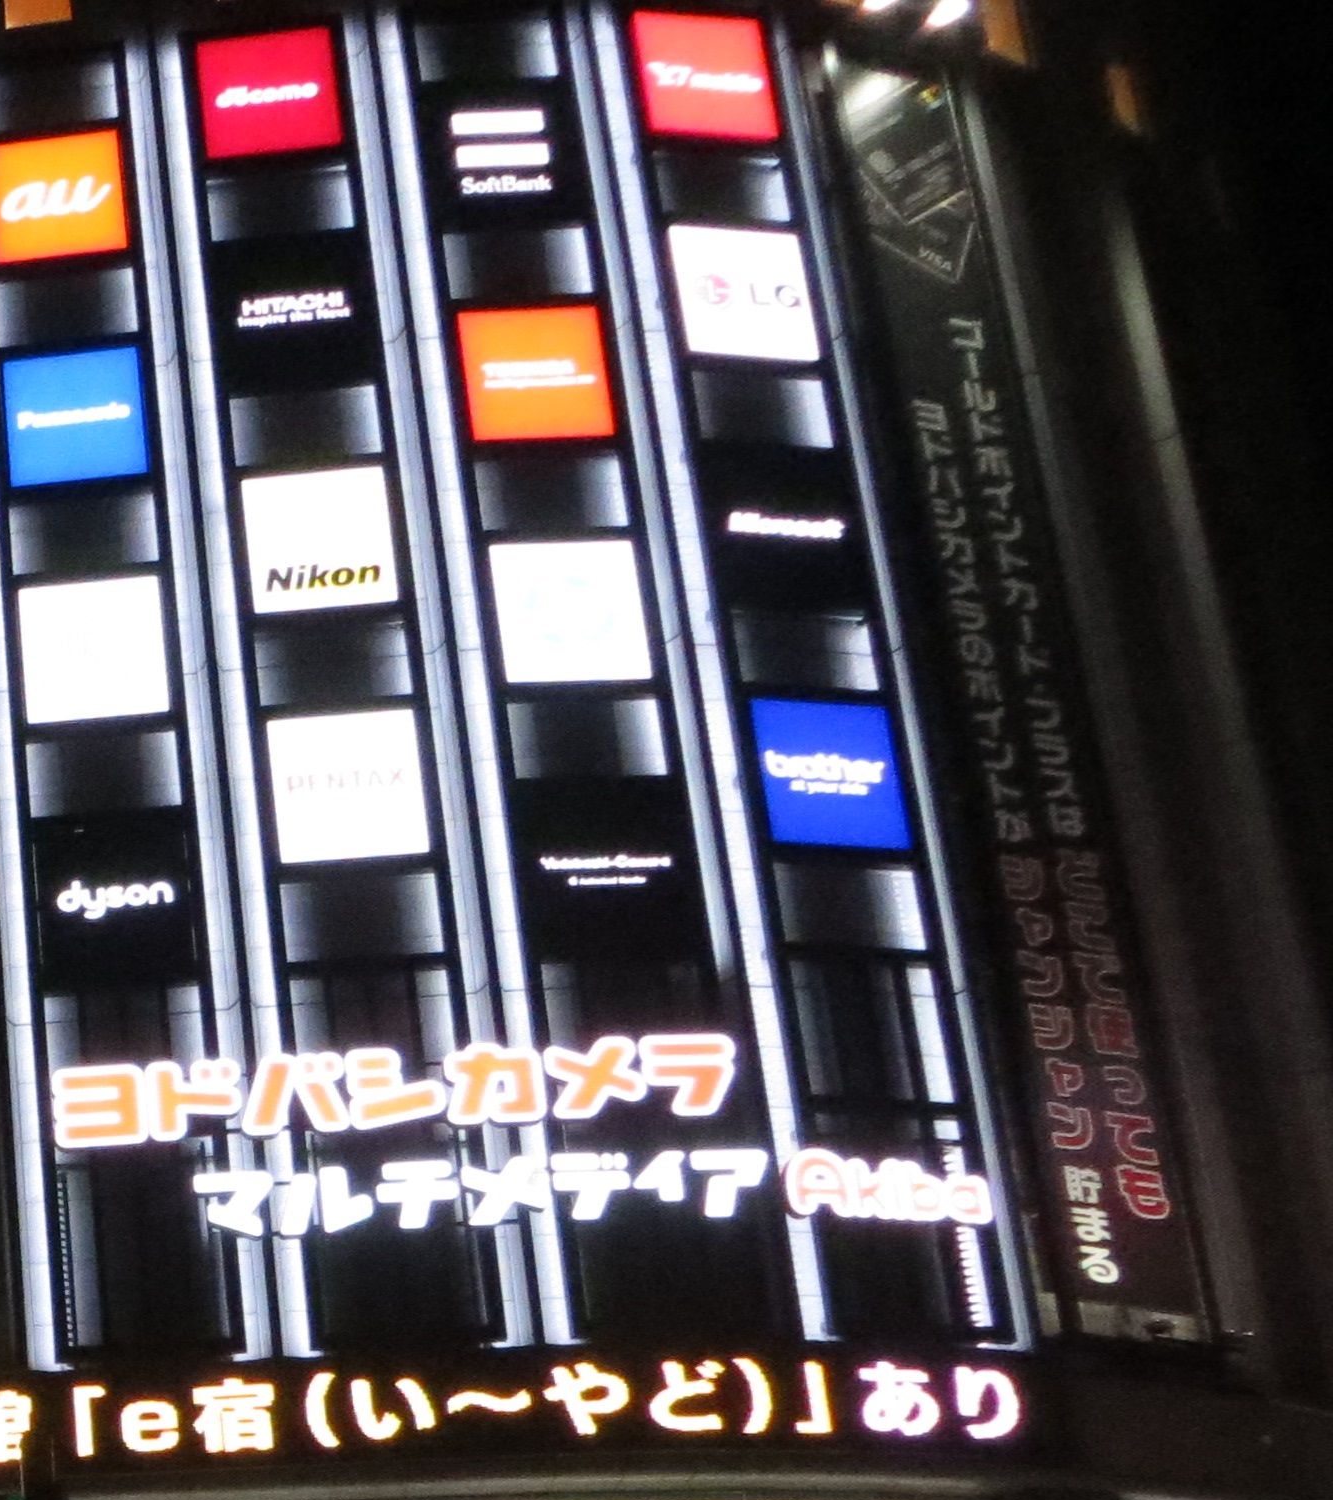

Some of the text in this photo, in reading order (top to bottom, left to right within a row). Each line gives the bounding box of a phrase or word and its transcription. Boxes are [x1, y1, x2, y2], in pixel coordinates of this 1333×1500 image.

[215, 82, 319, 109] docomo
[0, 175, 112, 222] au
[460, 175, 552, 196] SoftBank
[241, 291, 346, 314] HITACHI
[265, 562, 381, 592] Nikon
[56, 879, 175, 920] dyson
[52, 1033, 737, 1149] ヨドバシカメラ
[192, 1148, 994, 1237] マルチメディア Akiba
